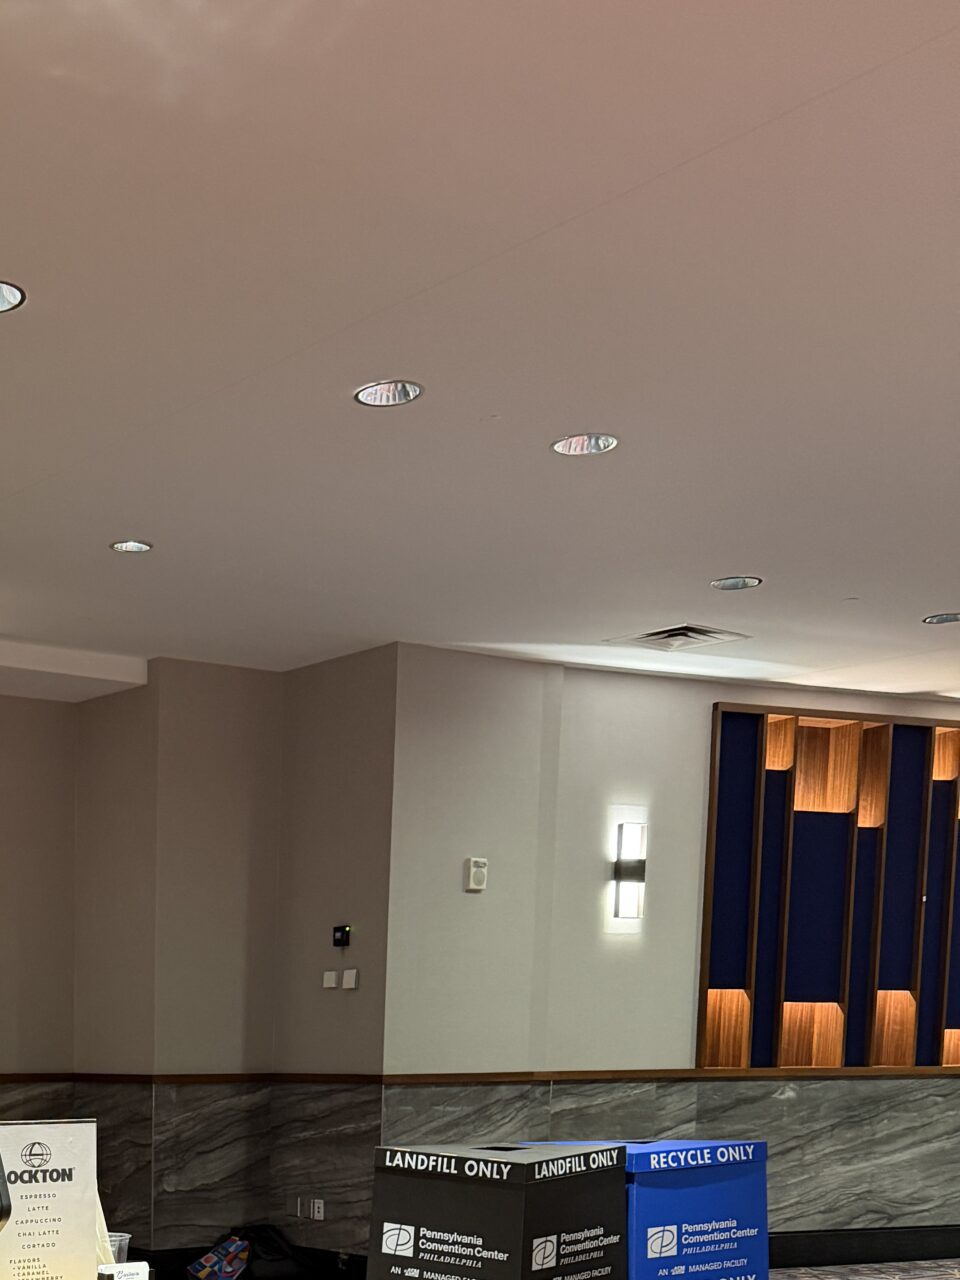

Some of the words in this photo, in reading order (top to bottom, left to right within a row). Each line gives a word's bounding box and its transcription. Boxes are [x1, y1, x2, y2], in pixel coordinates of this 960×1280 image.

[385, 1150, 458, 1174] LANDFILL
[464, 1159, 512, 1180] ONLY
[534, 1154, 587, 1180] LANDFILL
[589, 1149, 619, 1170] ONLY
[650, 1148, 712, 1170] RECYCLE
[716, 1144, 755, 1163] ONLY
[6, 1167, 73, 1185] OCKTON
[15, 1217, 62, 1226] CAPPUCCINO
[681, 1218, 737, 1234] Pennsylvania
[38, 1229, 60, 1237] LATTE
[419, 1227, 483, 1246] Pennsylvania
[560, 1225, 604, 1243] Pennsylvania
[681, 1230, 731, 1245] Convention
[731, 1227, 759, 1239] Center
[21, 1242, 56, 1250] CORTADO
[418, 1239, 474, 1256] Convention
[474, 1247, 510, 1261] Center
[559, 1239, 598, 1255] Convention
[598, 1234, 621, 1247] Center
[681, 1241, 738, 1255] PHILADELPHIA
[418, 1252, 482, 1268] PHILADELPHIA
[559, 1250, 604, 1266] PHILADELPHIA
[657, 1268, 669, 1276] AN
[688, 1261, 722, 1273] MANAGED
[723, 1257, 748, 1268] FACILITY
[390, 1265, 401, 1275] AN
